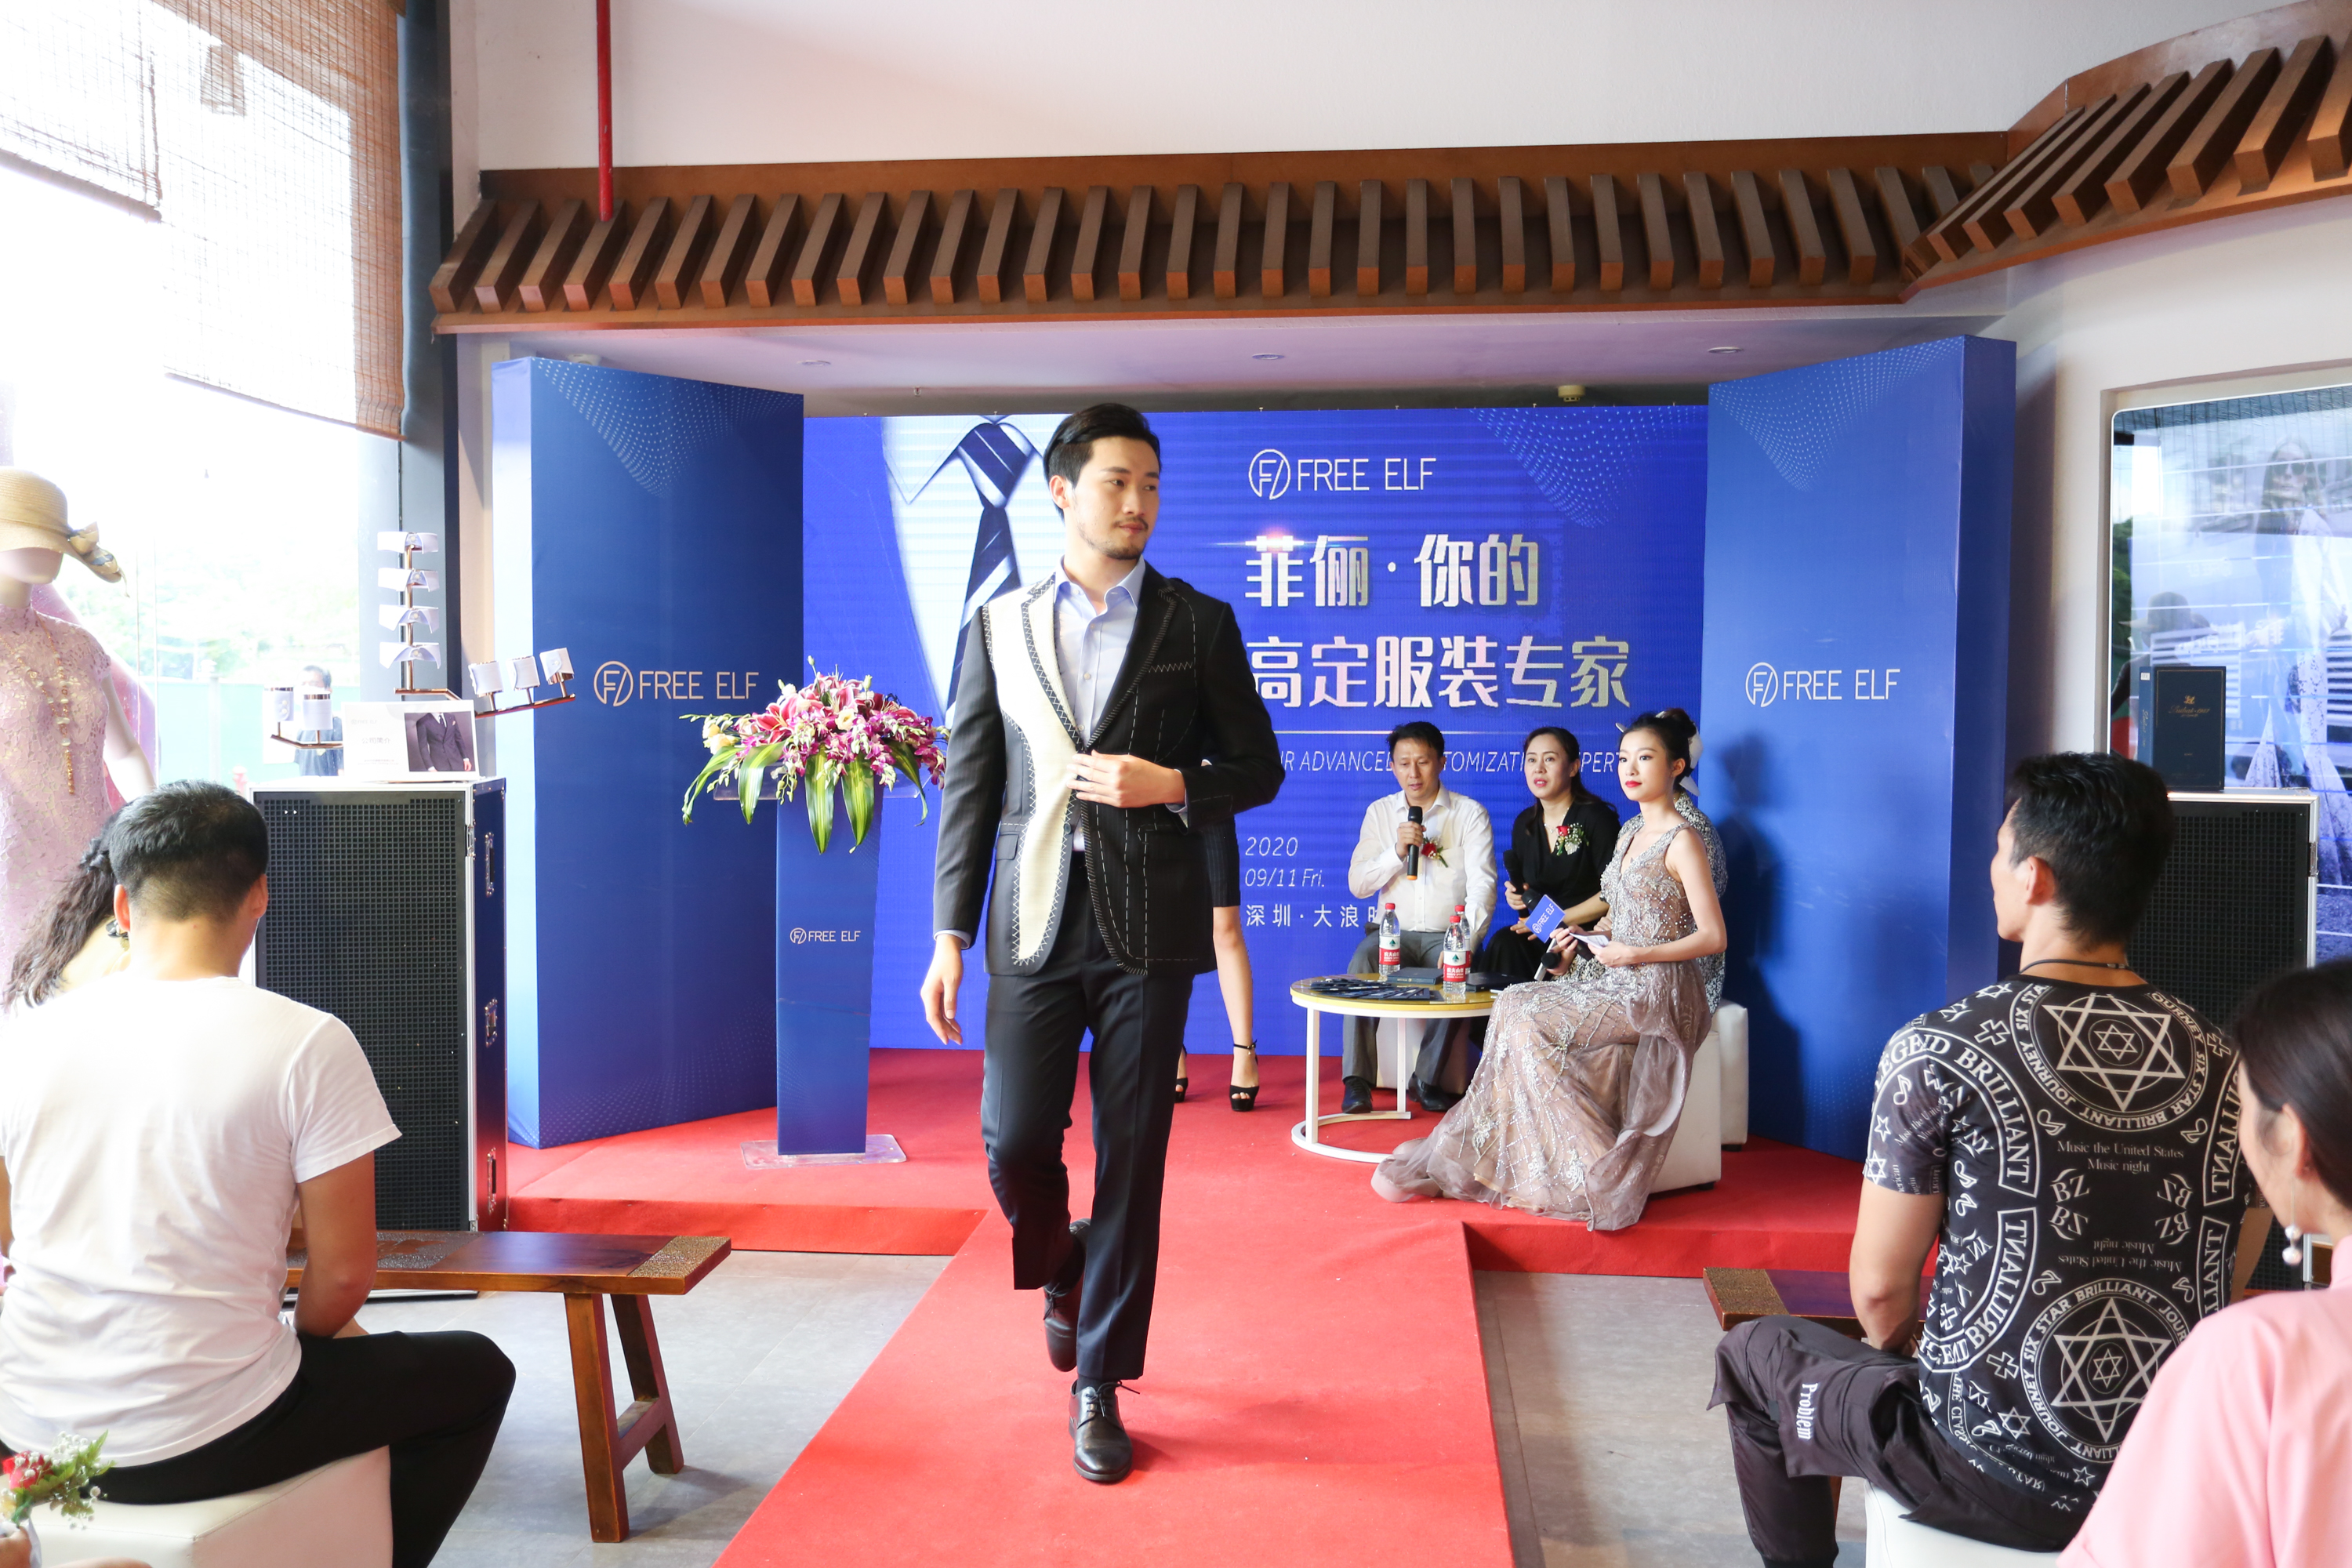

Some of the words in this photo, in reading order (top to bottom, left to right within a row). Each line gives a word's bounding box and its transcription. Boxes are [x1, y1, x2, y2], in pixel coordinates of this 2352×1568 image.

[1298, 458, 1370, 491] FREE
[1385, 457, 1437, 491] ELF
[639, 670, 704, 700] FREE
[716, 671, 760, 699] ELF
[1247, 636, 1630, 708] 高定服装专家
[1783, 670, 1842, 700] FREE
[1855, 668, 1900, 700] ELF
[1443, 751, 1525, 772] TOMIZATI
[1245, 837, 1298, 857] 2020
[1245, 867, 1295, 887] 09/11
[1301, 868, 1325, 887] Fri.
[1537, 912, 1550, 927] FREE
[1545, 902, 1555, 916] ELF
[808, 930, 837, 942] FREE
[840, 930, 861, 942] ELF
[2021, 984, 2050, 1004] STA
[2016, 1007, 2029, 1031] SIX
[2151, 992, 2204, 1044] OURNEY
[2019, 1040, 2077, 1105] JOURNEY
[2195, 1051, 2206, 1077] SIX
[2170, 1080, 2203, 1116] STAR
[1954, 1047, 2030, 1185] BRILLIANT
[2079, 1106, 2168, 1129] BRILLIANT
[2056, 1139, 2090, 1153] Music
[2092, 1142, 2111, 1155] the
[2114, 1143, 2151, 1157] United
[2153, 1145, 2184, 1159] States
[2087, 1158, 2119, 1171] Music
[2122, 1160, 2151, 1174] night
[2051, 1174, 2090, 1203] BZ
[2074, 1281, 2158, 1304] BRILLIANT
[2036, 1299, 2072, 1334] STAR
[2159, 1305, 2189, 1342] JOUR
[2024, 1336, 2040, 1363] SIX
[1796, 1383, 1818, 1439] Problem
[2023, 1368, 2067, 1438] JOURNEY
